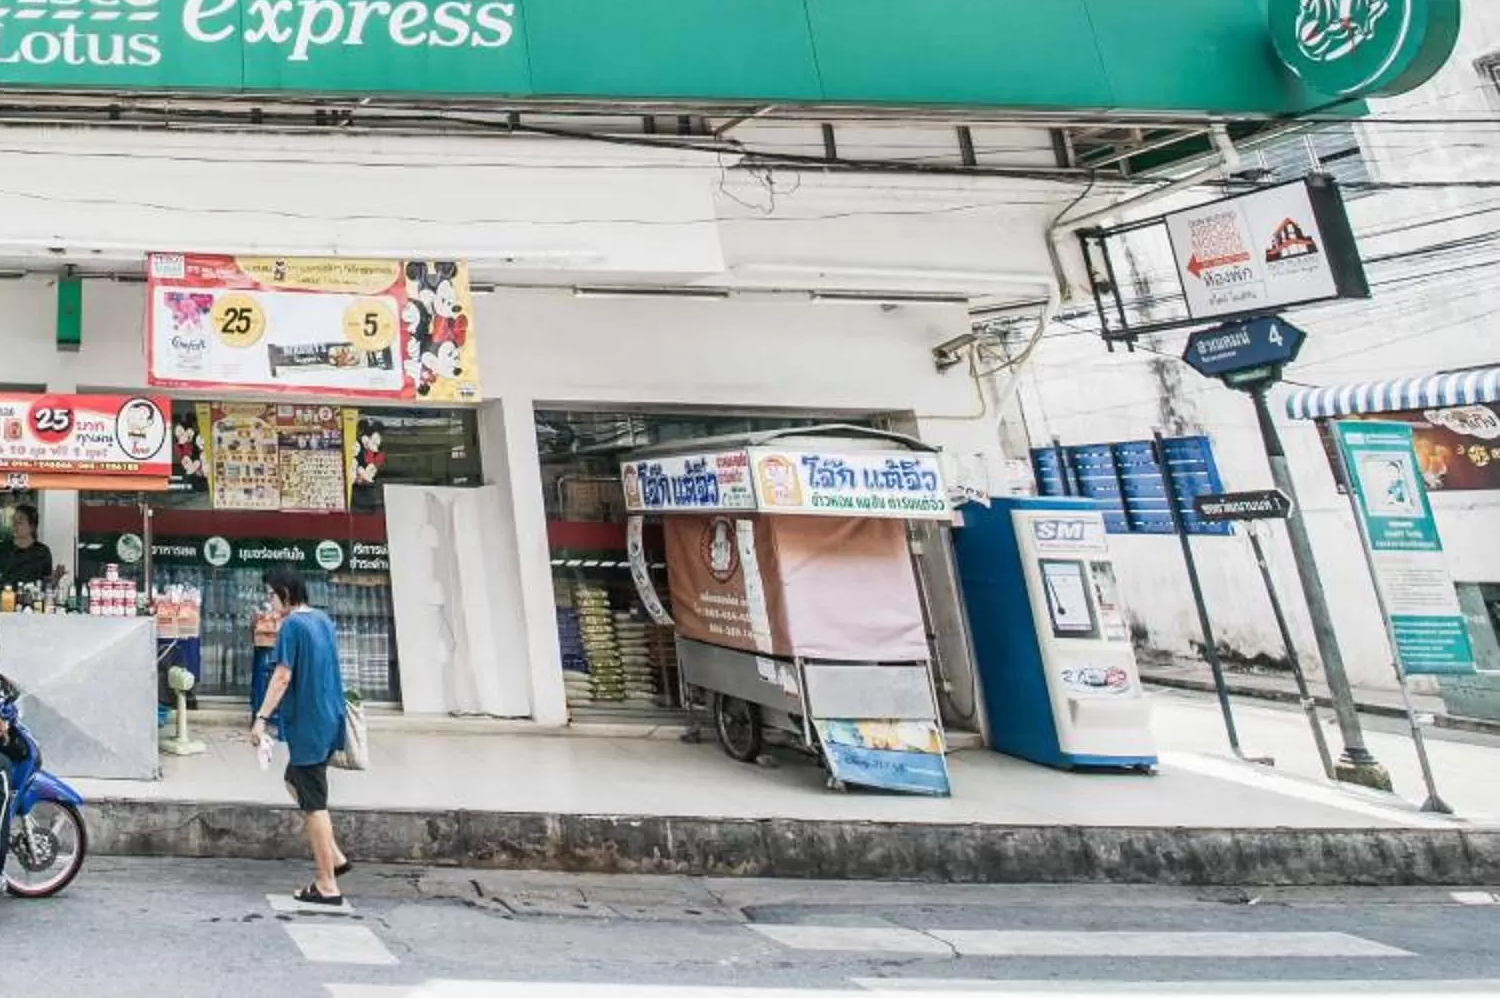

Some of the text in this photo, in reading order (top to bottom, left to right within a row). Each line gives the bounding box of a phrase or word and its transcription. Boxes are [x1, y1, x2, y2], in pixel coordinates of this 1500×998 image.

[221, 307, 253, 334] 25
[363, 313, 378, 337] 5
[1268, 323, 1283, 346] 4
[35, 408, 70, 432] 25
